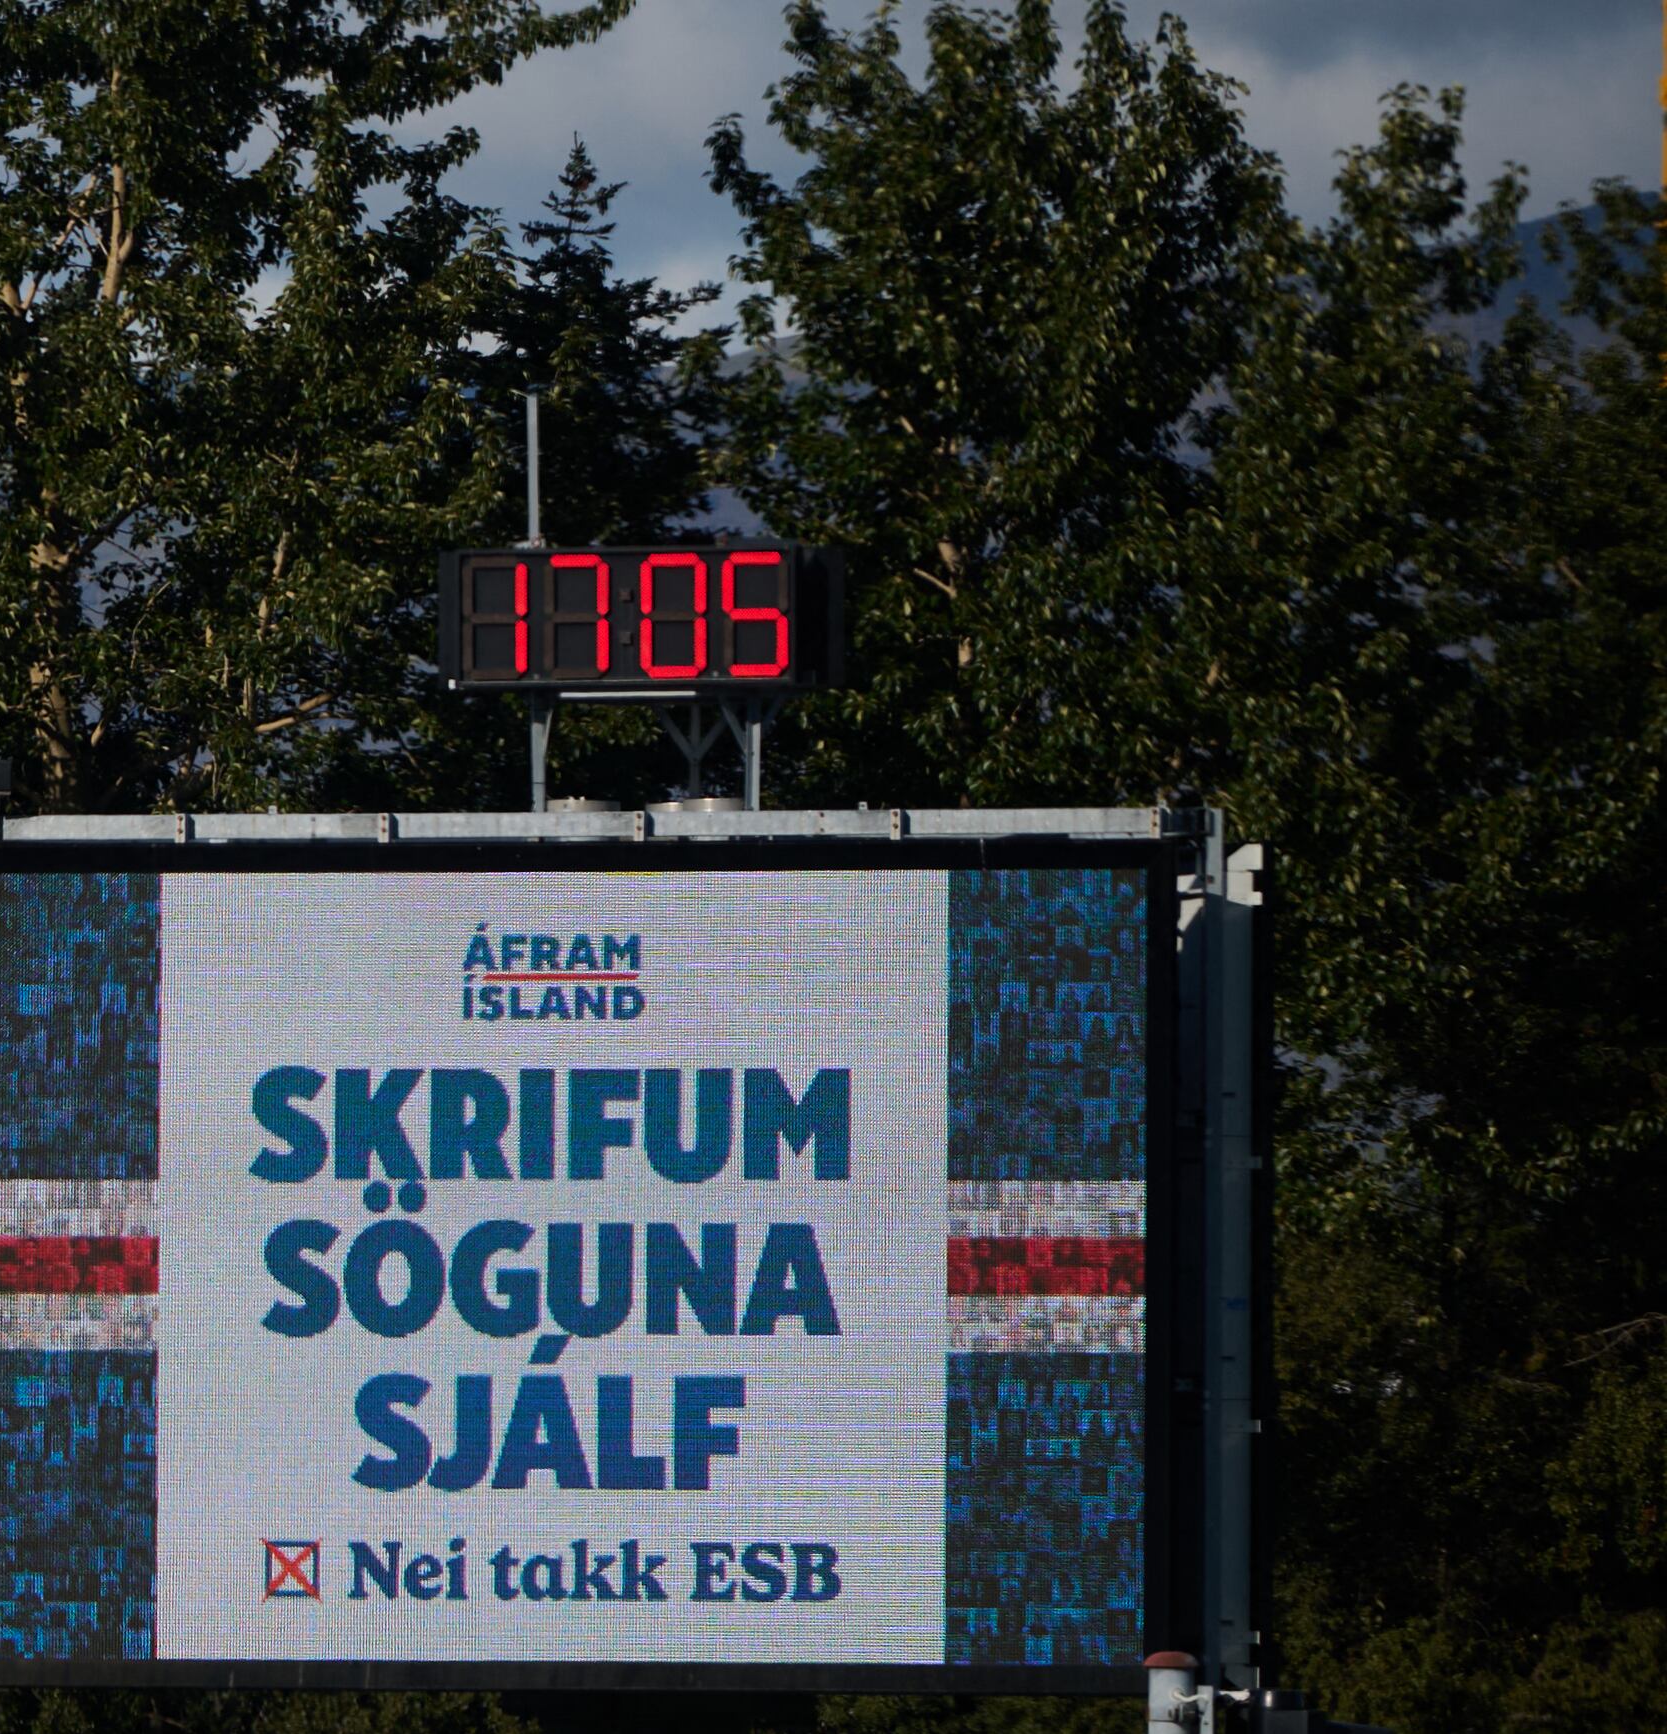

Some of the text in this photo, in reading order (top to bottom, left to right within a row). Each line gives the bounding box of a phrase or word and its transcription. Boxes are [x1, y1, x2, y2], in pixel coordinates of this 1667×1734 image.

[462, 923, 642, 972] ÁFRAM
[462, 974, 645, 1021] ÍSLAND
[248, 1067, 851, 1182] SKRIFUM
[261, 1181, 842, 1338] SÖGUNA
[351, 1335, 746, 1492] SJÁLF
[348, 1541, 842, 1602] Nei takk ESB
